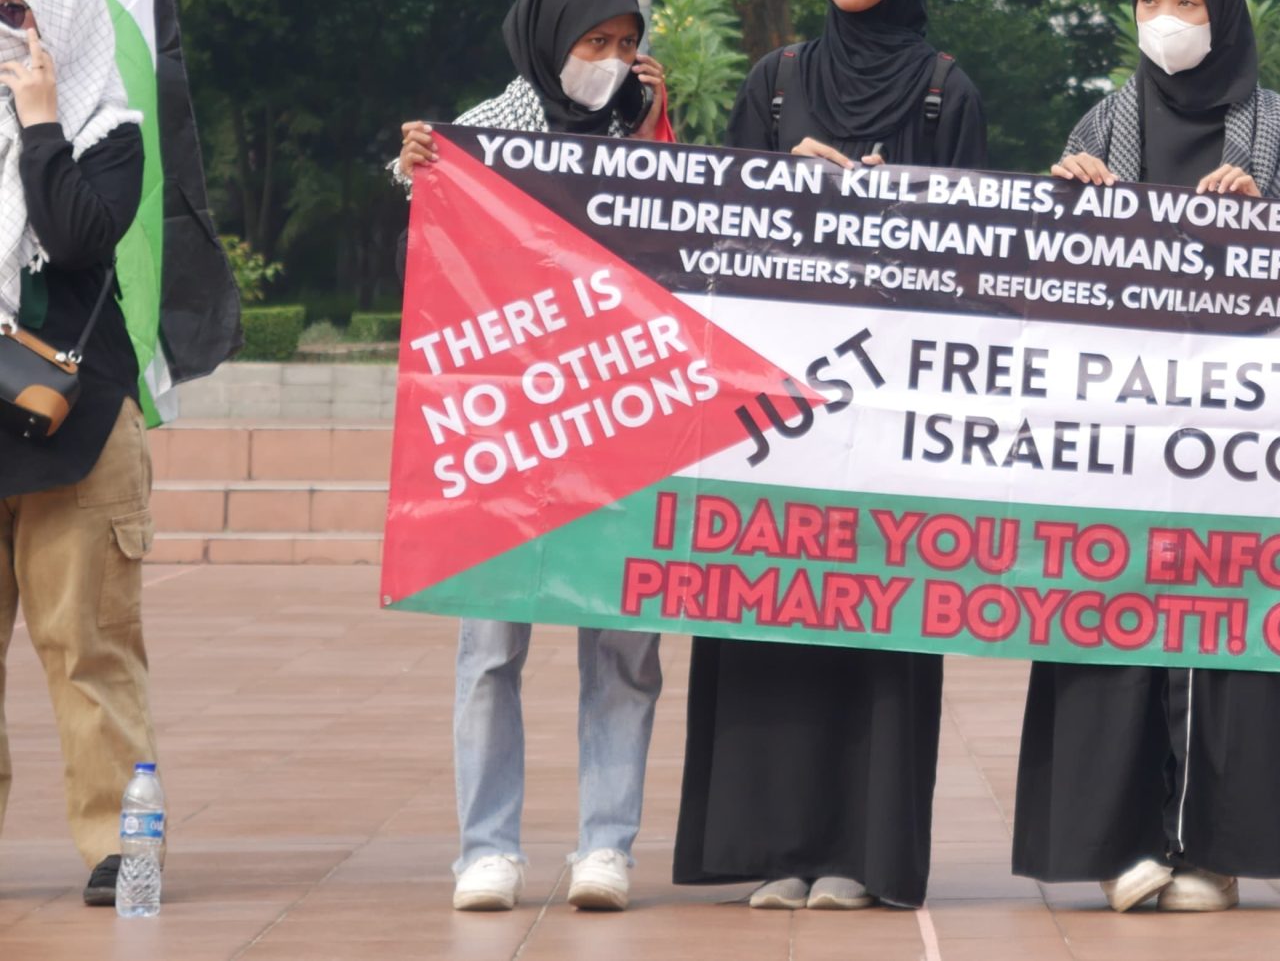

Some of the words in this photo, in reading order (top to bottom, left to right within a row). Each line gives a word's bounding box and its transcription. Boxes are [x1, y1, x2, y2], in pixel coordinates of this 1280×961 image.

[477, 135, 583, 174] YOUR
[591, 144, 734, 186] MONEY
[741, 158, 822, 194] CAN
[841, 168, 918, 202] KILL
[927, 174, 1064, 220] BABIES,
[1073, 186, 1139, 219] AID
[587, 193, 803, 247] CHILDRENS,
[814, 212, 1016, 258] PREGNANT
[1025, 229, 1214, 280] WOMANS,
[411, 289, 567, 377] THERE
[572, 268, 623, 319] IS
[680, 249, 856, 289] VOLUNTEERS,
[864, 264, 963, 298] POEMS,
[978, 274, 1115, 310] REFUGEES,
[1121, 286, 1250, 316] CIVILIANS
[420, 384, 506, 445] NO
[521, 315, 688, 405] OTHER
[734, 327, 886, 468] JUST
[908, 339, 1049, 398] FREE
[433, 359, 720, 499] SOLUTIONS
[902, 411, 1136, 475] ISRAELI
[653, 491, 678, 550] I
[692, 494, 859, 564] DARE
[870, 509, 1020, 575] YOU
[1034, 521, 1129, 582] TO
[621, 557, 913, 634] PRIMARY
[922, 579, 1248, 655] BOYCOTT!
